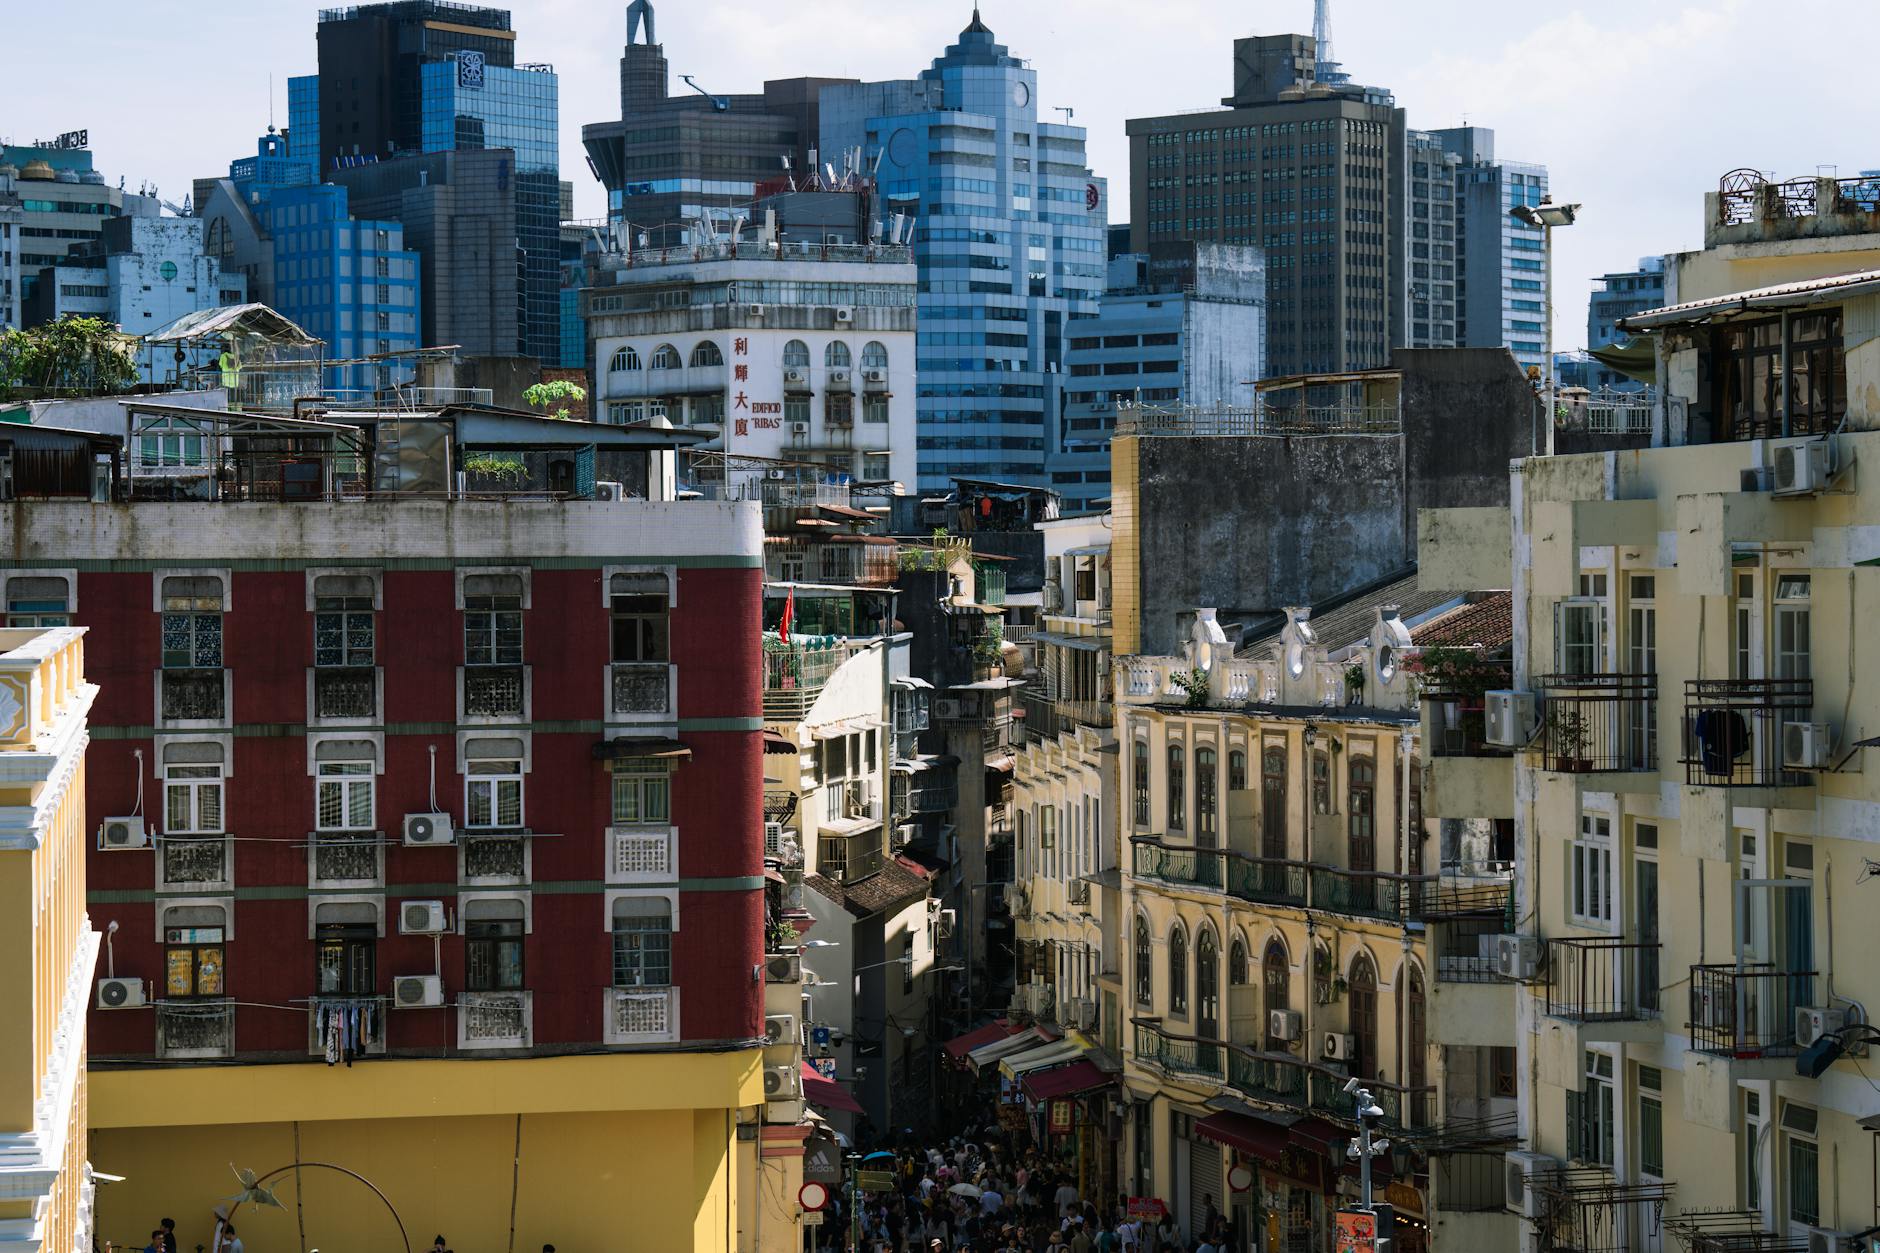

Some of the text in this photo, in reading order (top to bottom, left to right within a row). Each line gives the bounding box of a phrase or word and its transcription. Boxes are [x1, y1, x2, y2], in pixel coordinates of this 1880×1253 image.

[734, 337, 748, 437] 利輝大廈
[752, 402, 781, 413] EDIFICIO
[808, 1164, 834, 1172] adidas
